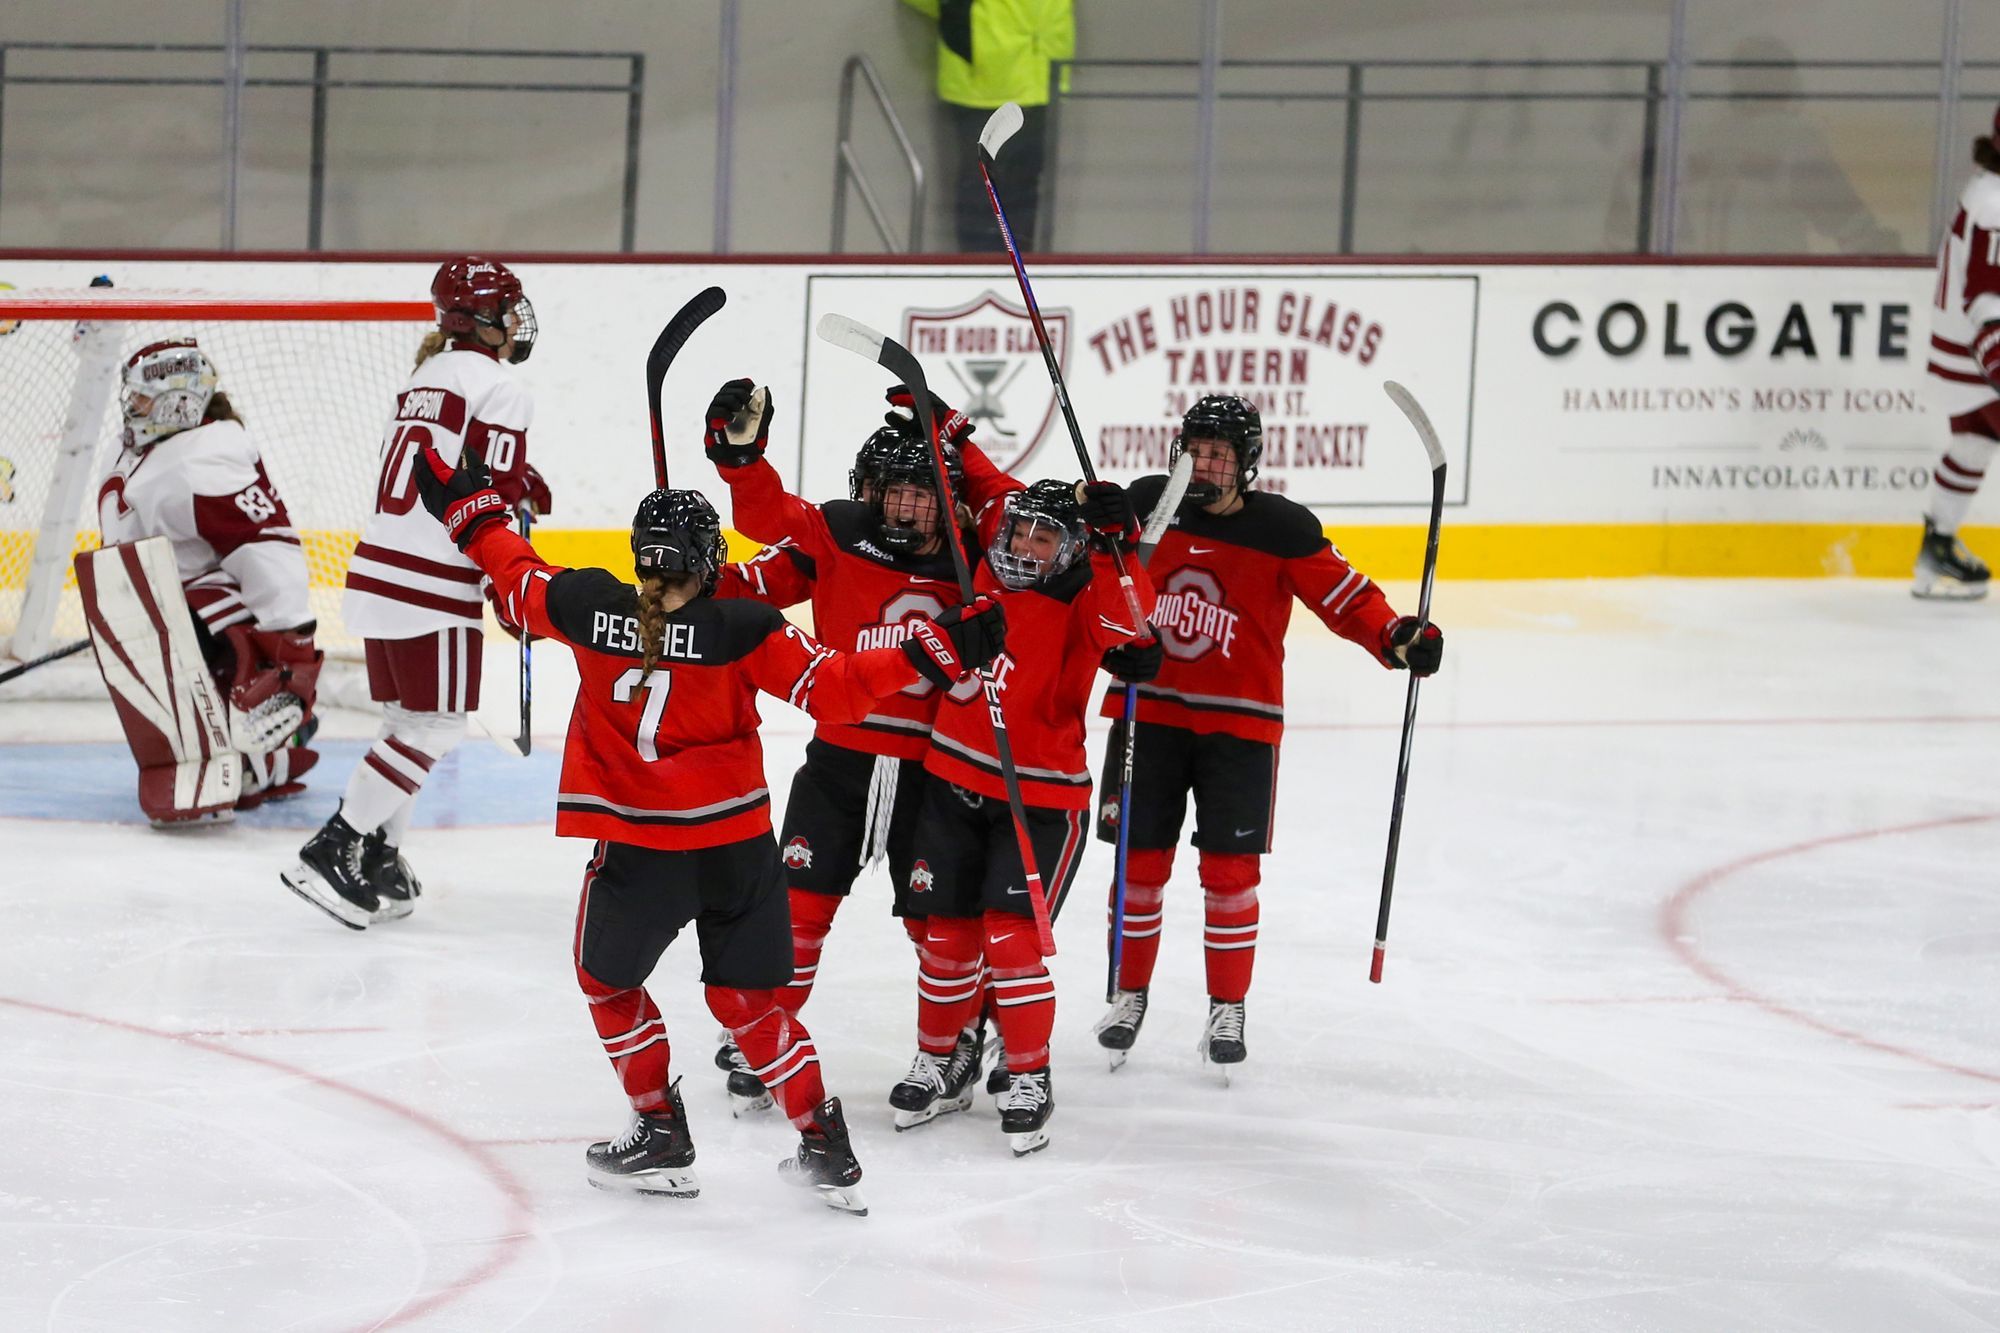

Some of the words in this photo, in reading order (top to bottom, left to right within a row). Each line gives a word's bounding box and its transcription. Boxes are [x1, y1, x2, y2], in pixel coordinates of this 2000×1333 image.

[917, 327, 947, 353] THE
[954, 327, 998, 353] HOUR
[1089, 307, 1157, 375] THE
[1170, 288, 1260, 342] HOUR
[1277, 290, 1384, 366] GLASS
[1532, 301, 1910, 358] COLGATE
[1165, 350, 1309, 385] TAVERN
[1562, 387, 1741, 413] HAMILTON'S
[1752, 387, 1833, 413] MOST
[1843, 387, 1928, 413] ICON.
[483, 431, 516, 473] 10
[1294, 424, 1369, 468] HOCKEY
[1652, 466, 1931, 491] INNATCOLGATE.CO
[234, 485, 277, 524] 83
[655, 548, 664, 565] 7
[193, 672, 227, 748] TRUE
[613, 668, 672, 763] 7
